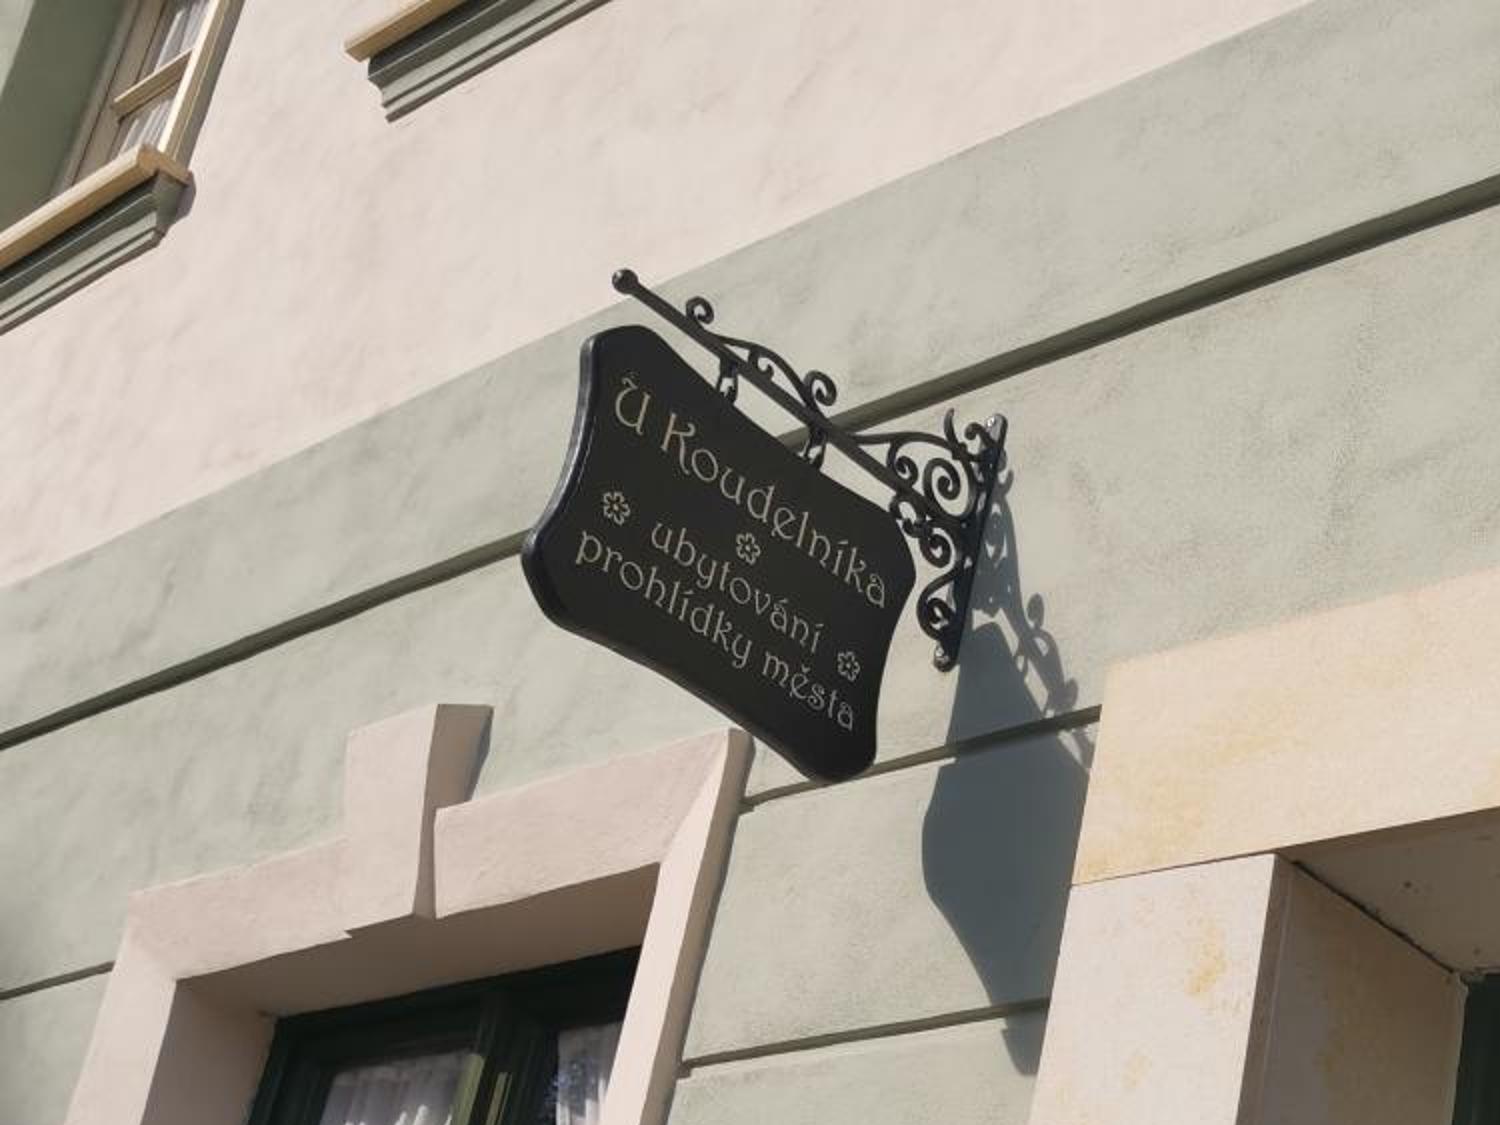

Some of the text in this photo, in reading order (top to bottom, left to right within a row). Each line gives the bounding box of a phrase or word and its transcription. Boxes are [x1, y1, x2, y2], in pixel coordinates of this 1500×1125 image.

[614, 375, 887, 608] U Koudelníka
[650, 521, 826, 652] ubytování
[575, 530, 856, 731] prohlídky města
